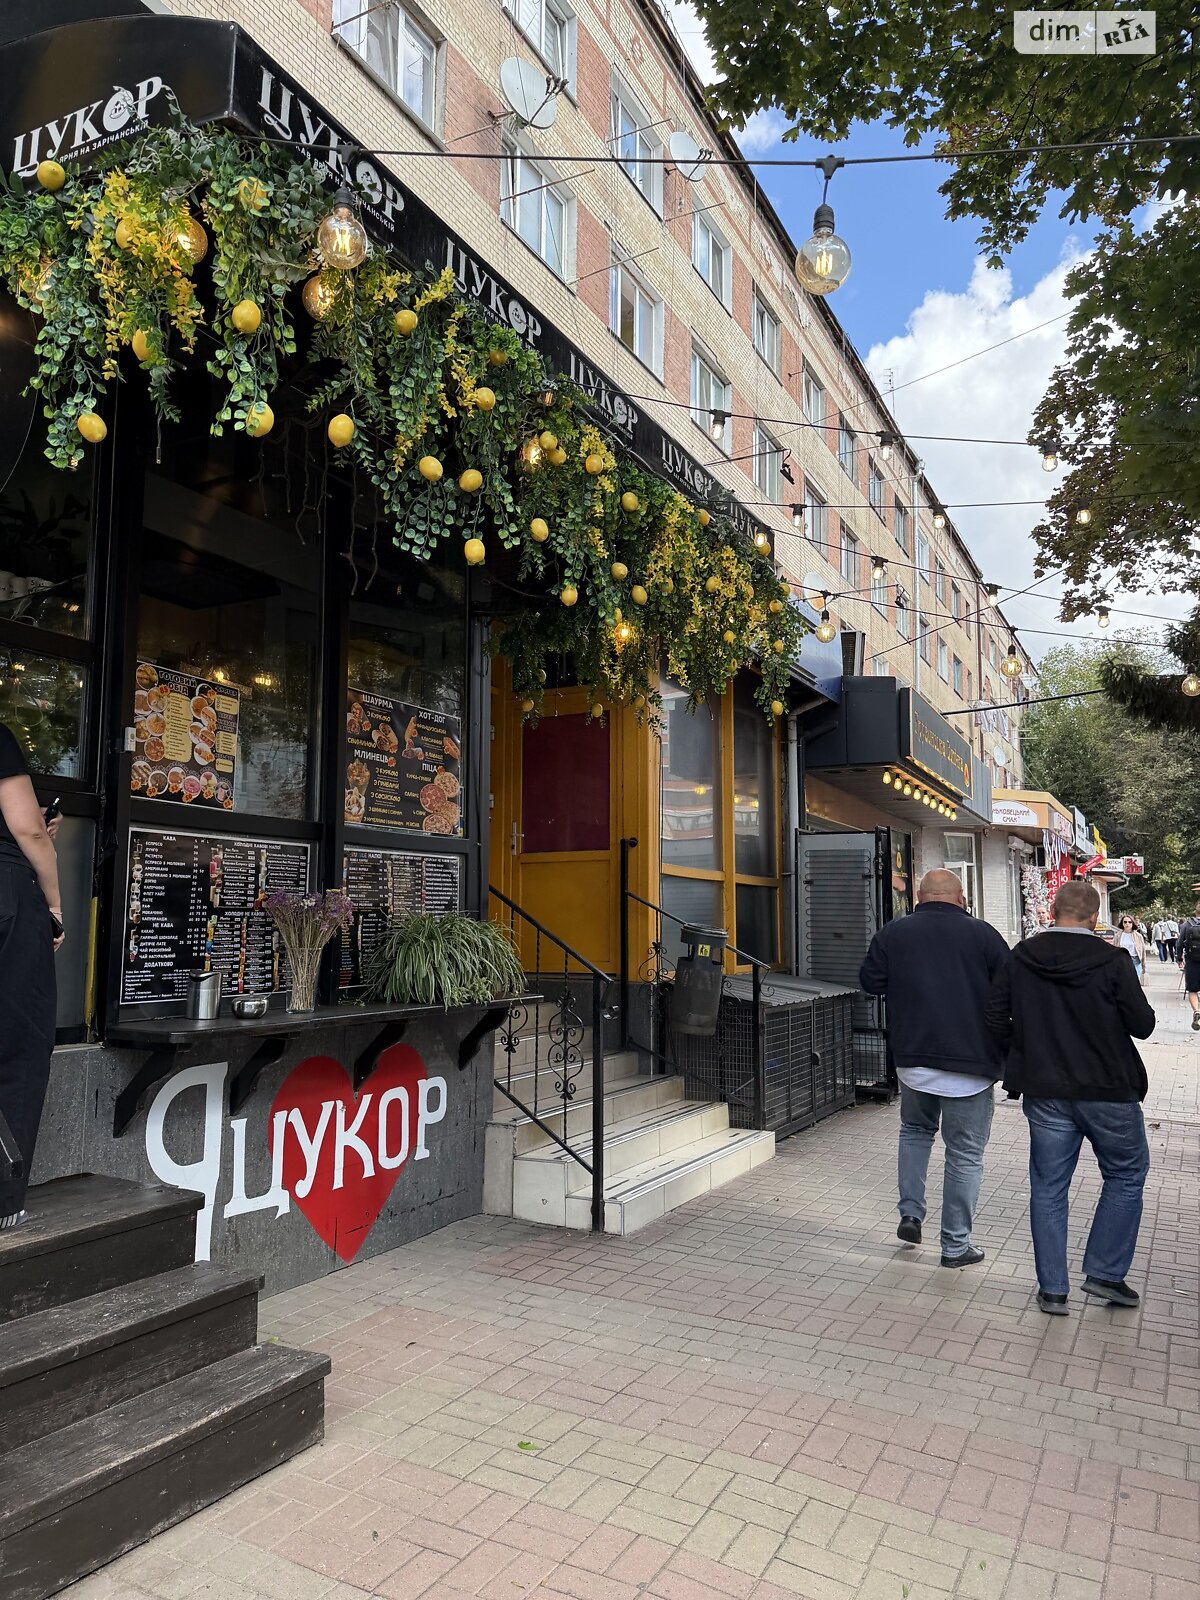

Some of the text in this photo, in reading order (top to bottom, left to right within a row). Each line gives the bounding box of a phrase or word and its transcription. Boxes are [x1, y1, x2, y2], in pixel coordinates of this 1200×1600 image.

[13, 76, 163, 177] ЦУКОР
[257, 65, 405, 223] ЦУКОР
[446, 236, 542, 347] ЦУКОР
[569, 350, 638, 434] ЦУКОР
[661, 435, 713, 500] ЦУКОР
[159, 670, 197, 688] ГОТОВИЙ
[168, 682, 189, 696] ОБІД
[362, 694, 394, 709] ШАУРМА
[418, 710, 446, 724] ХОТ-ДОГ
[354, 749, 389, 763] МЛИНЕЦЬ
[223, 1076, 448, 1220] ЦУКОР
